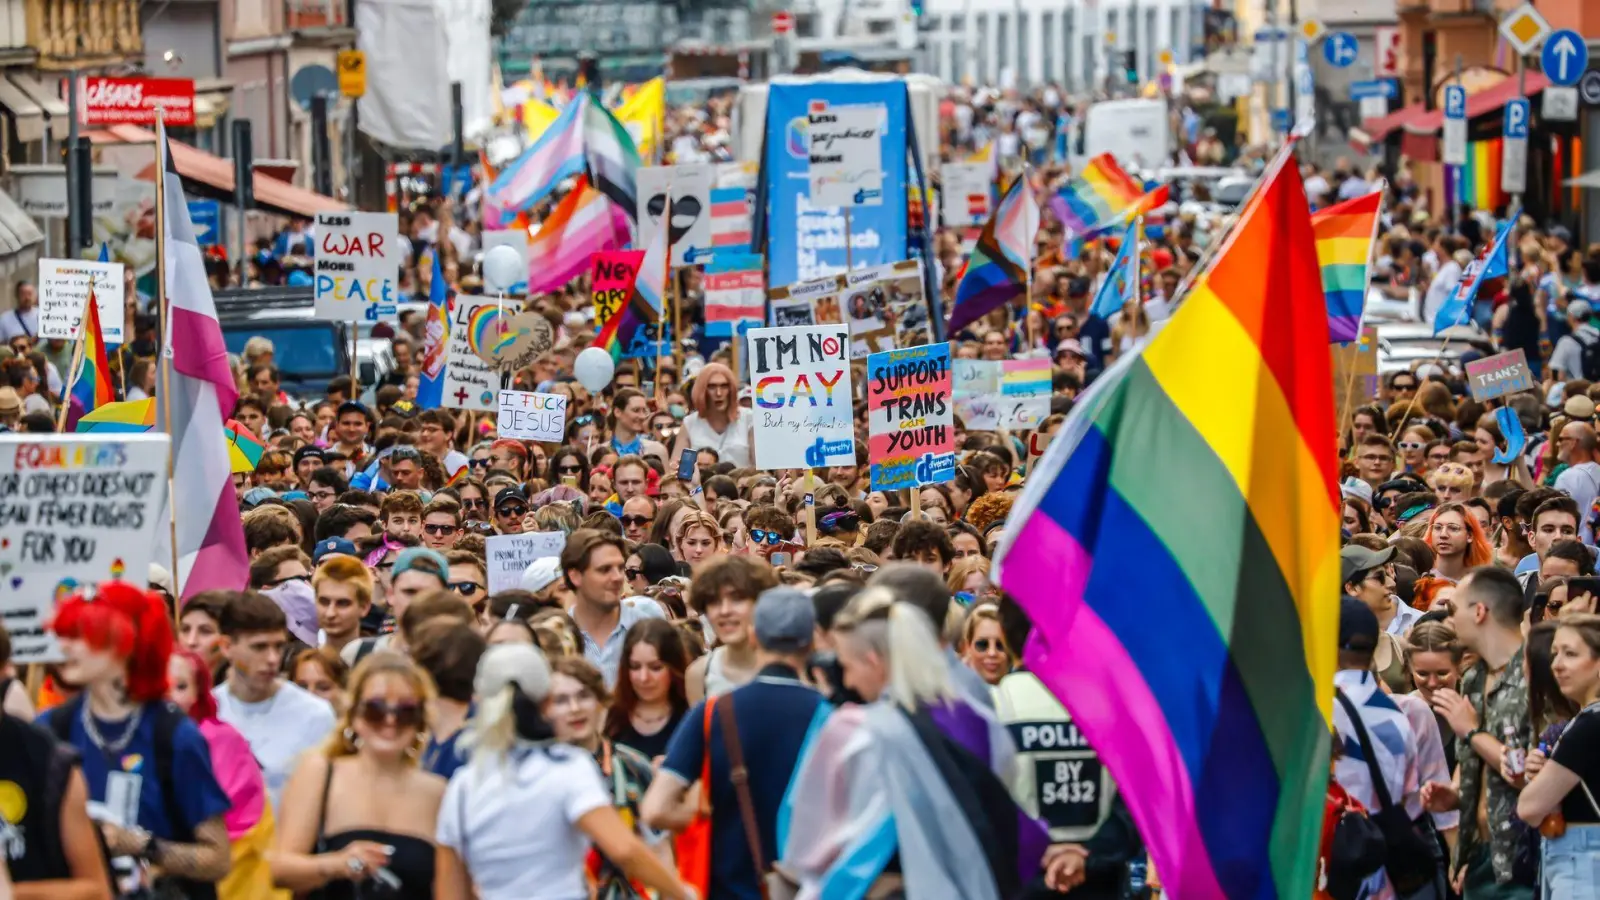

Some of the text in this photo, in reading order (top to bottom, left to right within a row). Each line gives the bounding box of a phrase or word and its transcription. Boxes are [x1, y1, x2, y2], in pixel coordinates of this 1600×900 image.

[1509, 103, 1524, 133] P
[323, 232, 384, 257] WAR
[317, 275, 393, 302] PEACE
[753, 333, 847, 373] I'M NOT
[873, 355, 947, 395] SUPPORT
[501, 393, 565, 410] I FUCK
[756, 370, 844, 409] GAY
[880, 391, 946, 422] TRANS
[501, 410, 562, 433] JESUS
[763, 412, 784, 428] But
[788, 420, 800, 432] my
[900, 418, 926, 429] care
[887, 424, 946, 454] YOUTH
[14, 443, 68, 470] EQUAL
[928, 458, 954, 469] diversity
[24, 472, 80, 499] OTHERS
[83, 472, 121, 497] DOES
[36, 501, 87, 528] FEWER
[91, 502, 145, 529] RIGHTS
[20, 531, 97, 564] FOR YOU
[494, 550, 523, 561] PRINCE
[511, 539, 534, 554] my
[502, 560, 537, 571] CHARM
[1055, 760, 1083, 783] BY
[1043, 780, 1096, 805] 5432
